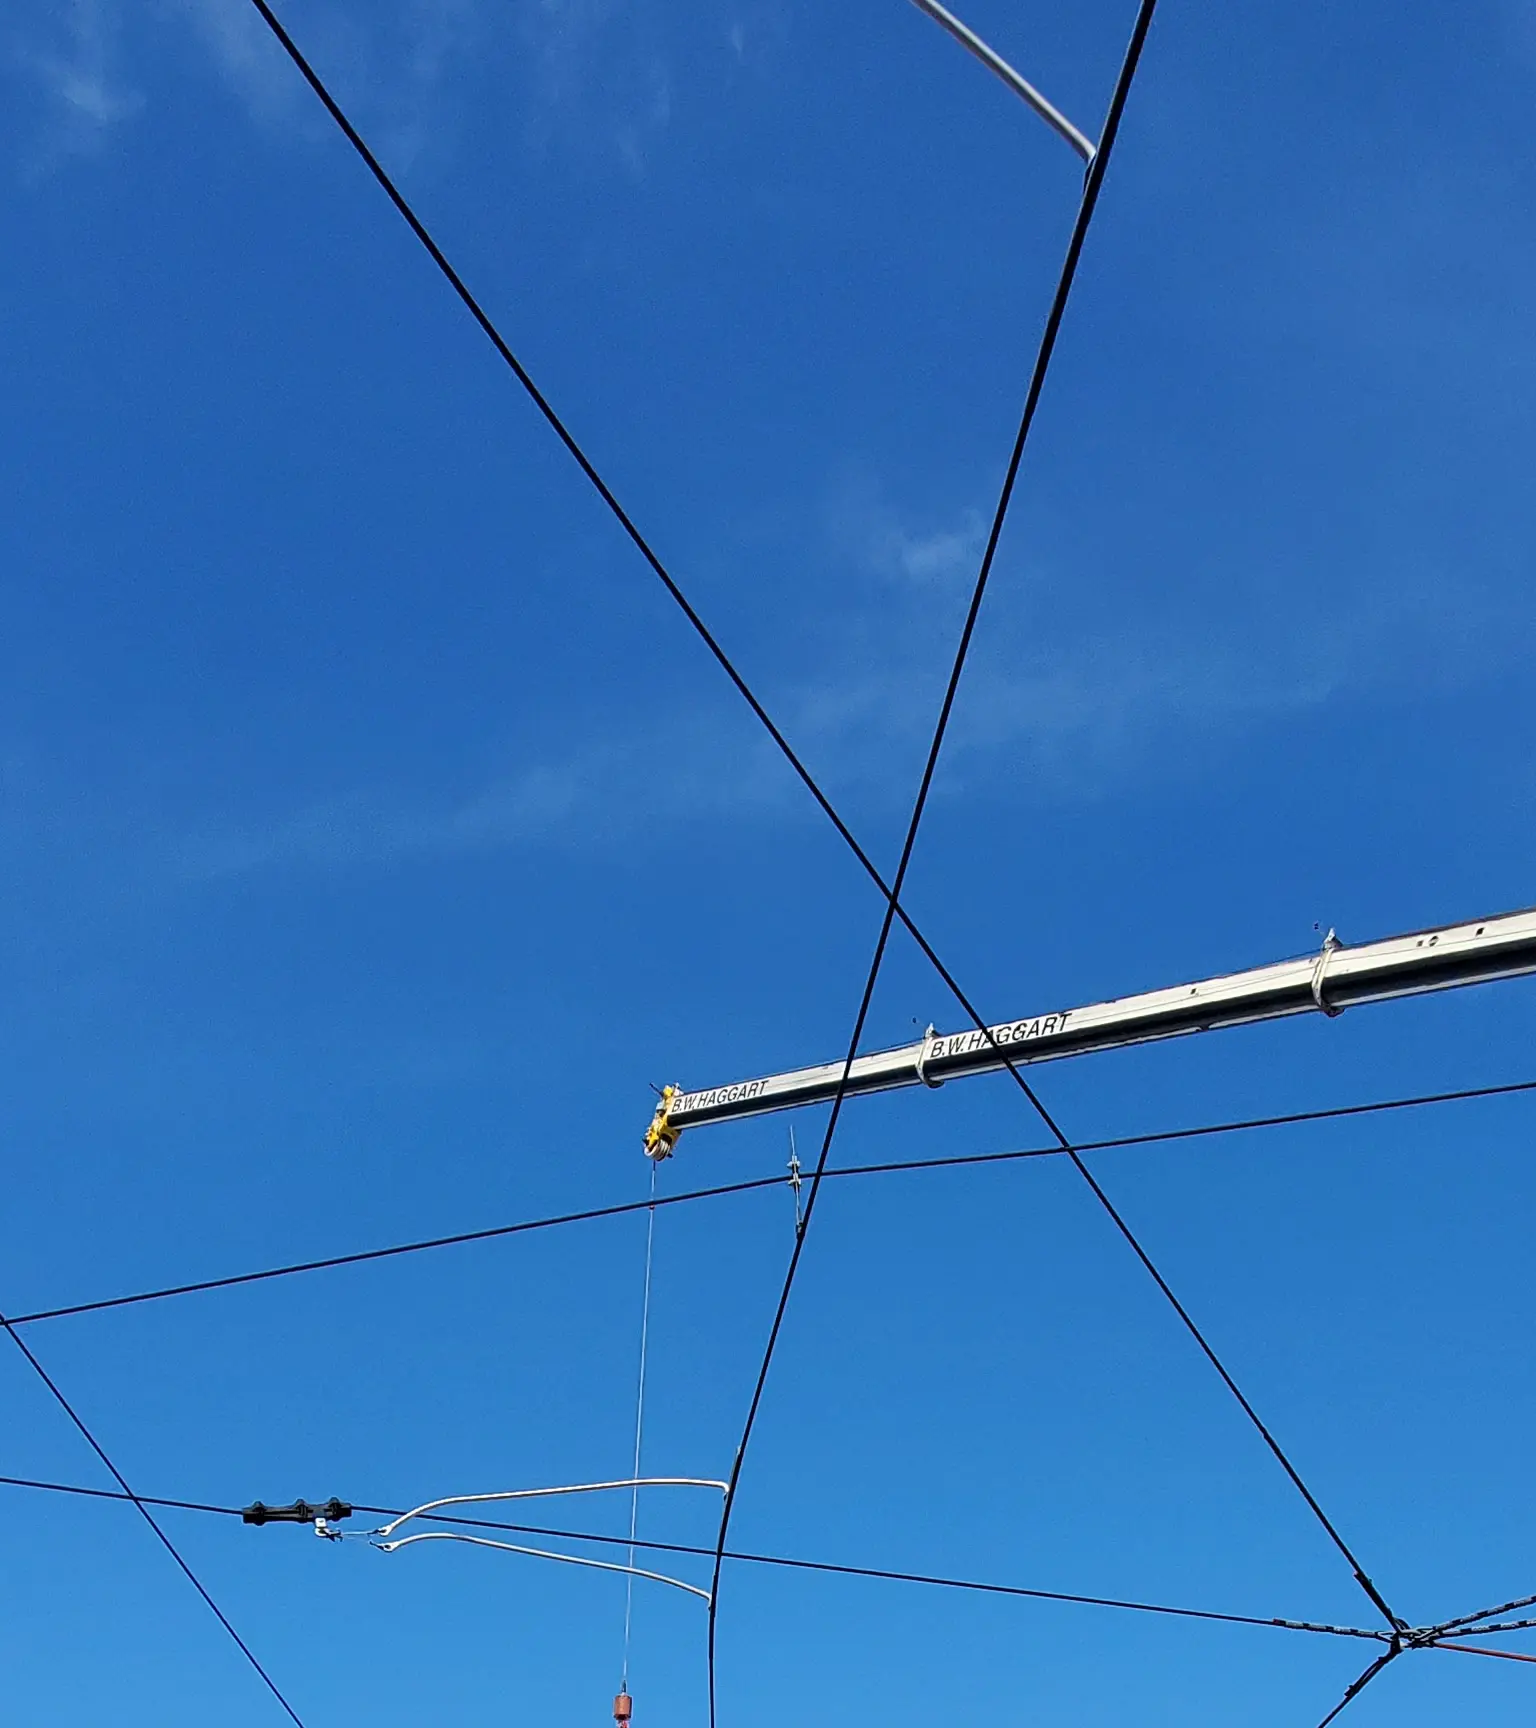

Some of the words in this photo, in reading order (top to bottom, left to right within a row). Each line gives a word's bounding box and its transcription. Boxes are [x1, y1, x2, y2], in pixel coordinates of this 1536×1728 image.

[931, 1034, 965, 1058] B.W.
[967, 1012, 1073, 1050] HAGGART
[671, 1095, 696, 1113] B.W.
[697, 1080, 769, 1109] HAGGART
